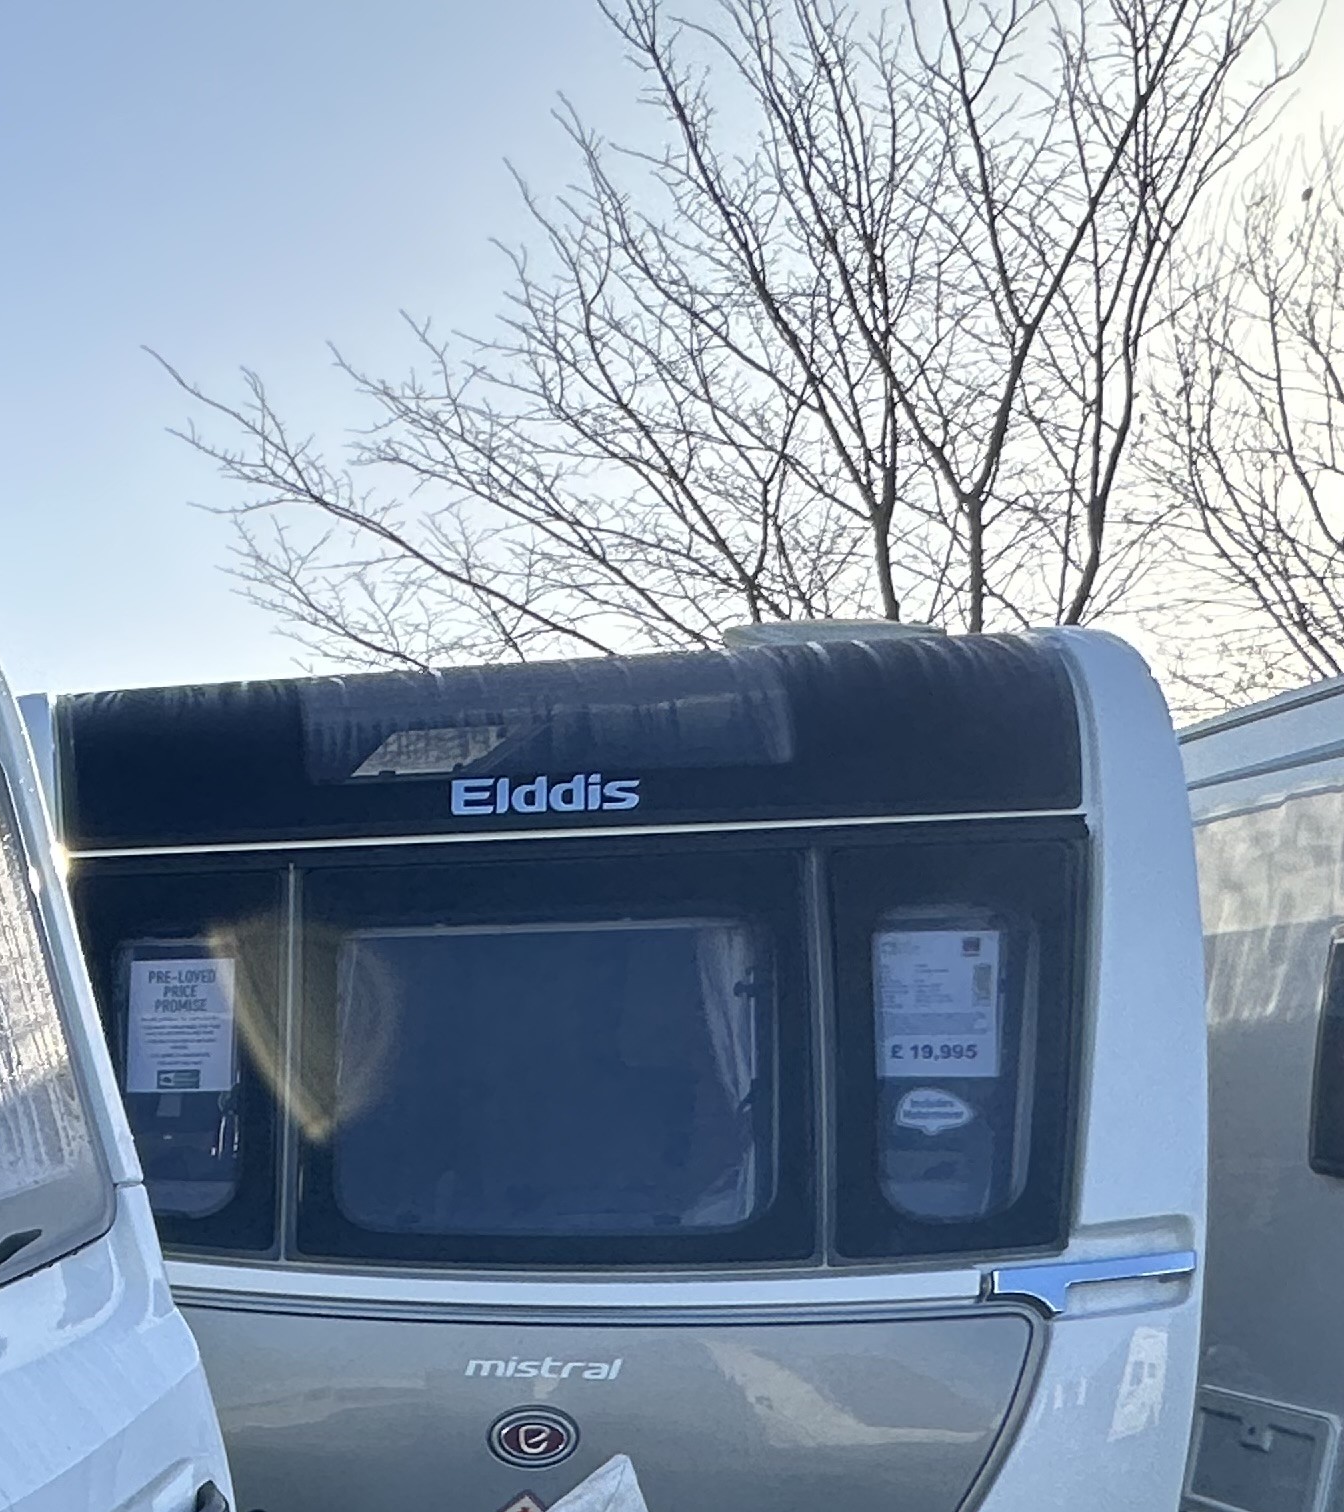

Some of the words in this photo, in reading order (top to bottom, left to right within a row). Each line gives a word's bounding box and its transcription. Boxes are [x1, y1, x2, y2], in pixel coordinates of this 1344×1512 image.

[450, 773, 641, 816] Elddis
[148, 968, 216, 984] PRE-LOVED
[162, 984, 198, 998] PRICE
[154, 998, 208, 1014] PROMISE
[890, 1043, 904, 1060] £
[909, 1043, 978, 1061] 19,995
[464, 1356, 624, 1380] mistral
